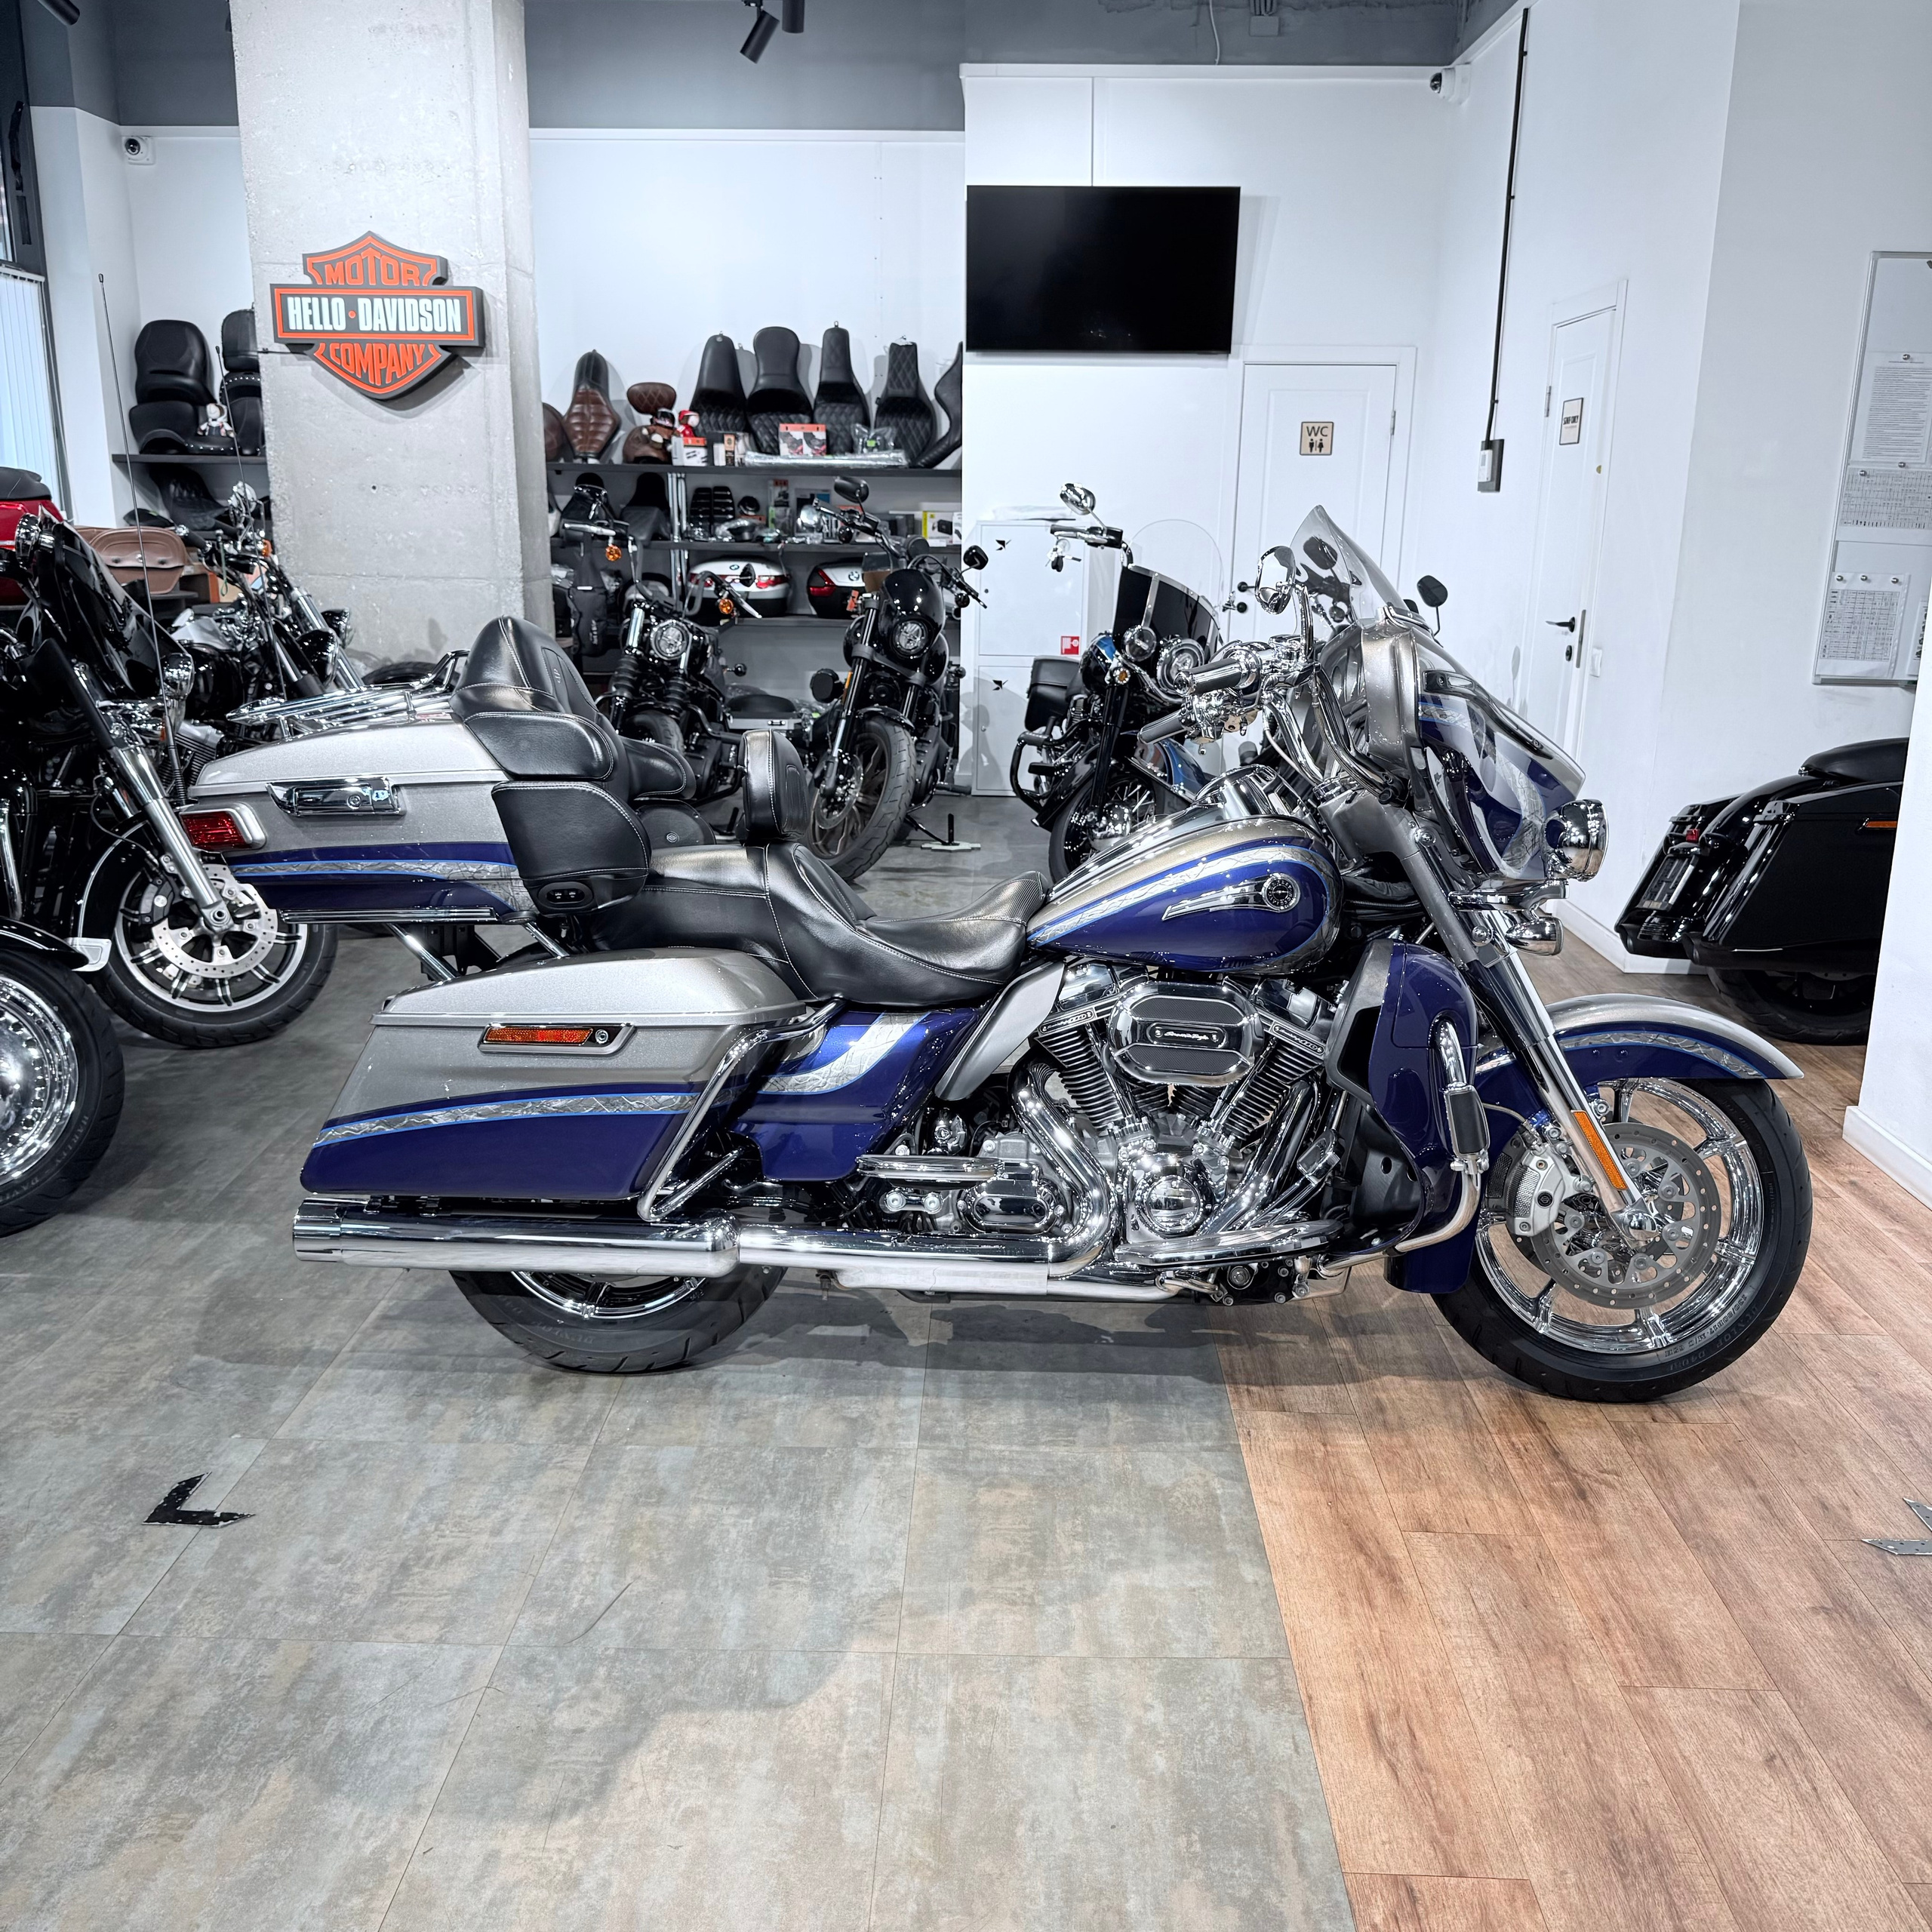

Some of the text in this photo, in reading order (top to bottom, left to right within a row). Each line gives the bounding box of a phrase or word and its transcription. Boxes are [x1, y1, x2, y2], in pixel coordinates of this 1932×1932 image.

[325, 247, 420, 286] MOTOR
[287, 297, 462, 332] HELLO DAVIDSON
[329, 342, 426, 386] COMPANY
[1306, 426, 1328, 437] WC
